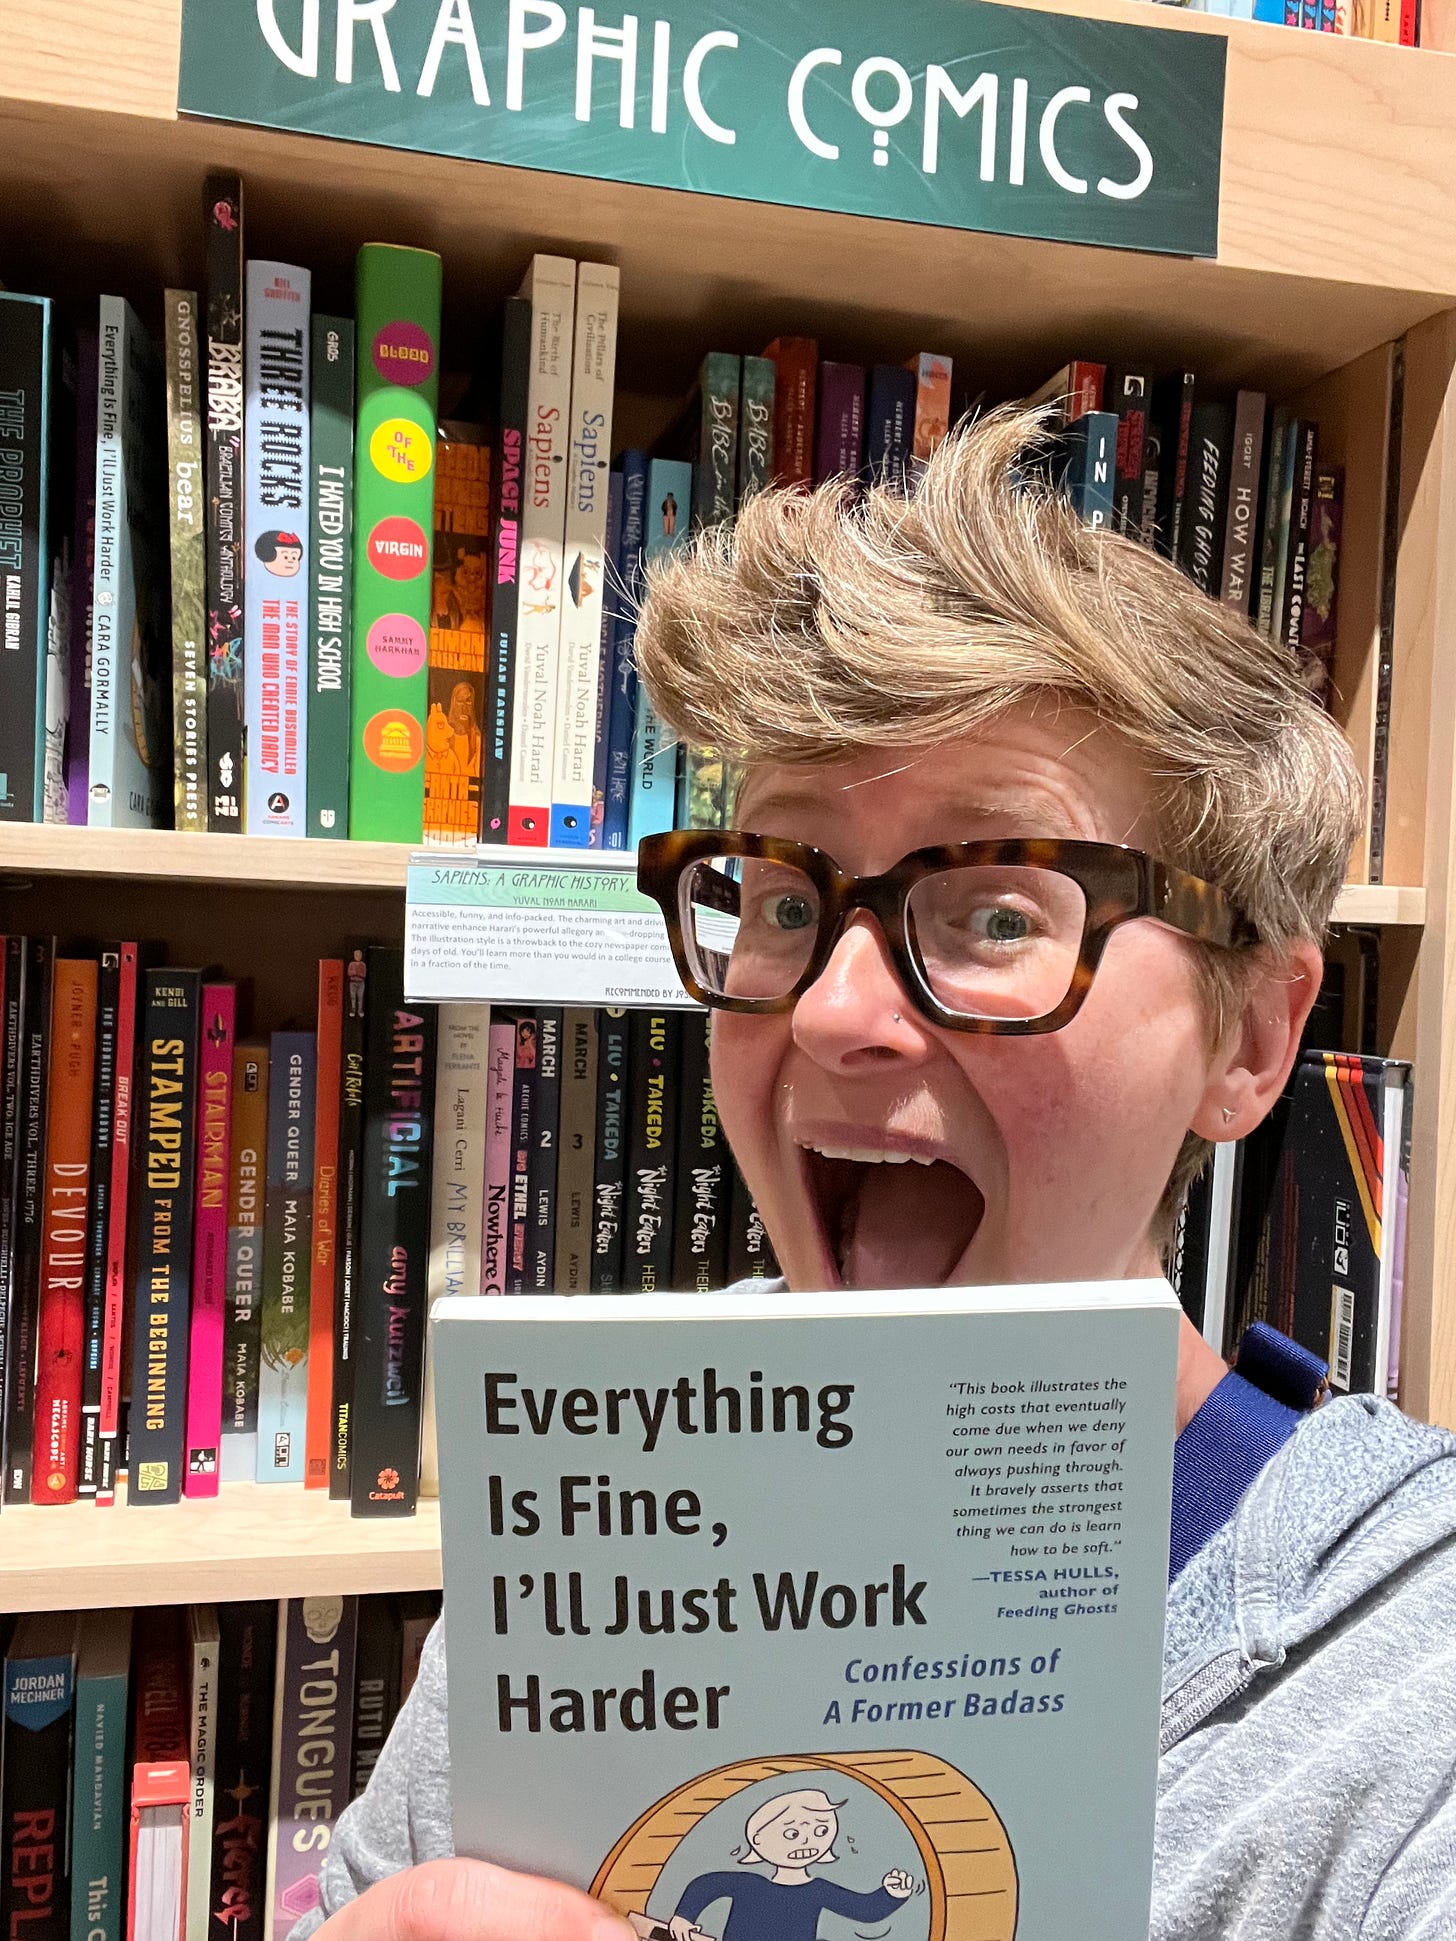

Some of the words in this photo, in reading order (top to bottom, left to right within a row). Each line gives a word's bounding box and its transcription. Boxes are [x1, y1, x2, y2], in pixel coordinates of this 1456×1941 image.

[788, 48, 1153, 199] COMICS
[101, 325, 118, 397] Everything
[327, 331, 338, 362] GROS
[380, 344, 429, 363] BLOOD
[177, 301, 192, 445] GNOSSPELIUS
[260, 328, 303, 412] THREE
[107, 399, 116, 408] Is
[100, 412, 116, 443] Fine,
[394, 431, 411, 448] OF
[103, 450, 116, 467] I’ll
[260, 421, 303, 509] ROCKS
[319, 464, 345, 477] I
[387, 445, 415, 472] THE
[501, 429, 521, 514] SPACE
[529, 404, 560, 508] Sapiens
[573, 411, 604, 513] Sapiens
[103, 470, 115, 496] Just
[176, 461, 198, 525] bear
[102, 501, 116, 533] Work
[319, 480, 344, 535] HATED
[1233, 488, 1251, 545] HOW
[100, 537, 114, 580] Harder
[319, 537, 343, 572] YOU
[374, 540, 423, 558] VIRGIN
[497, 520, 518, 584] JUNK
[6, 575, 20, 614] KAHLIL
[319, 576, 342, 593] IN
[262, 600, 280, 620] THE
[286, 600, 298, 617] THE
[318, 597, 342, 632] HIGH
[5, 616, 20, 650] GIBRAN
[97, 615, 111, 657] CARA
[262, 623, 280, 648] MAN
[286, 621, 298, 655] STORY
[375, 644, 420, 656] HARKHAM
[382, 635, 413, 646] SAMMY
[184, 641, 195, 691] SEVEN
[262, 653, 280, 679] WHO
[286, 658, 297, 672] OF
[317, 637, 341, 692] SCHOOL
[498, 632, 508, 682] JULIAN
[537, 644, 548, 683] Yuval
[579, 643, 591, 681] Yuval
[95, 658, 110, 734] GORMALLY
[261, 682, 280, 732] CREATED
[285, 675, 297, 706] ERNIE
[534, 688, 547, 729] Noah
[577, 688, 589, 728] Noah
[185, 699, 197, 766] STORIES
[284, 709, 297, 775] BUSHMILLER
[495, 688, 506, 759] HANSHAW
[260, 735, 279, 774] NANCY
[530, 733, 544, 784] Harari
[572, 732, 585, 782] Harari
[186, 773, 198, 820] PRESS
[432, 871, 491, 885] SAPIENS:
[496, 873, 505, 886] A
[512, 873, 568, 889] GRAPHIC
[571, 875, 629, 892] HISTORY,
[412, 909, 456, 919] Accessible,
[459, 911, 485, 921] funny,
[488, 912, 502, 920] and
[505, 913, 554, 923] info-packed.
[574, 915, 612, 925] charming
[627, 918, 642, 926] and
[513, 896, 540, 906] YUVAL
[543, 897, 565, 906] NOAH
[568, 898, 596, 907] HARARI
[605, 987, 659, 998] RECOMMENDED
[662, 988, 673, 998] BY
[541, 1019, 556, 1077] MARCH
[650, 1017, 665, 1051] LIU
[288, 1054, 301, 1119] GENDER
[148, 1039, 183, 1189] STAMPED
[646, 1074, 664, 1149] TAKEDA
[202, 1071, 227, 1208] STARMAN
[286, 1127, 299, 1181] QUEER
[541, 1131, 551, 1148] 2
[238, 1149, 257, 1238] GENDER
[538, 1189, 549, 1226] LEWIS
[152, 1199, 172, 1254] FROM
[284, 1200, 297, 1244] MAIA
[151, 1265, 169, 1303] THE
[235, 1246, 254, 1321] QUEER
[281, 1252, 295, 1314] KOBABE
[536, 1250, 546, 1287] AYDIN
[146, 1314, 168, 1430] BEGINNING
[237, 1343, 247, 1376] MAIA
[234, 1382, 246, 1427] KOBABE
[950, 1382, 985, 1394] “This
[991, 1381, 1025, 1393] book
[1031, 1380, 1099, 1393] illustrates
[1104, 1378, 1126, 1390] the
[484, 1368, 854, 1452] Everything
[946, 1403, 975, 1418] high
[980, 1403, 1015, 1414] costs
[1021, 1401, 1049, 1413] that
[1055, 1399, 1126, 1413] eventually
[952, 1425, 990, 1436] come
[995, 1423, 1020, 1434] due
[1026, 1421, 1062, 1433] when
[1068, 1423, 1087, 1432] we
[1092, 1420, 1125, 1433] deny
[945, 1447, 969, 1457] our
[974, 1446, 1002, 1456] own
[1008, 1442, 1048, 1454] needs
[1053, 1441, 1065, 1453] in
[1071, 1441, 1106, 1455] favor
[1111, 1439, 1127, 1453] of
[954, 1465, 1001, 1479] always
[1007, 1463, 1060, 1478] pushing
[1066, 1459, 1123, 1475] through.
[369, 1491, 404, 1500] Catapult
[971, 1485, 980, 1496] It
[986, 1484, 1036, 1497] bravely
[1041, 1483, 1089, 1494] asserts
[1095, 1481, 1123, 1492] that
[488, 1475, 541, 1536] Is
[560, 1475, 728, 1547] Fine,
[953, 1505, 1026, 1517] sometimes
[1032, 1503, 1054, 1514] the
[1059, 1501, 1122, 1515] strongest
[956, 1525, 991, 1539] thing
[996, 1527, 1014, 1535] we
[1020, 1525, 1044, 1534] can
[1049, 1522, 1066, 1533] do
[1071, 1521, 1080, 1532] is
[1086, 1520, 1121, 1531] learn
[1010, 1545, 1037, 1556] how
[1043, 1545, 1056, 1555] to
[1062, 1543, 1078, 1553] be
[1039, 1586, 1096, 1599] author
[1102, 1584, 1119, 1596] of
[1053, 1567, 1119, 1580] HULLS,
[493, 1572, 591, 1635] I’ll
[605, 1575, 738, 1635] Just
[753, 1564, 927, 1631] Work
[997, 1605, 1058, 1619] Feeding
[1064, 1604, 1117, 1615] Ghosts
[12, 1673, 65, 1690] JORDAN
[845, 1654, 1021, 1683] Confessions
[1030, 1648, 1061, 1673] of
[10, 1689, 64, 1704] MECHNER
[200, 1682, 208, 1713] THE
[497, 1669, 730, 1732] Harder
[823, 1700, 840, 1724] A
[851, 1698, 956, 1723] Former
[963, 1689, 1064, 1716] Badass
[197, 1718, 207, 1762] MAGIC
[293, 1649, 340, 1852] TONGUES
[194, 1765, 205, 1817] ORDER
